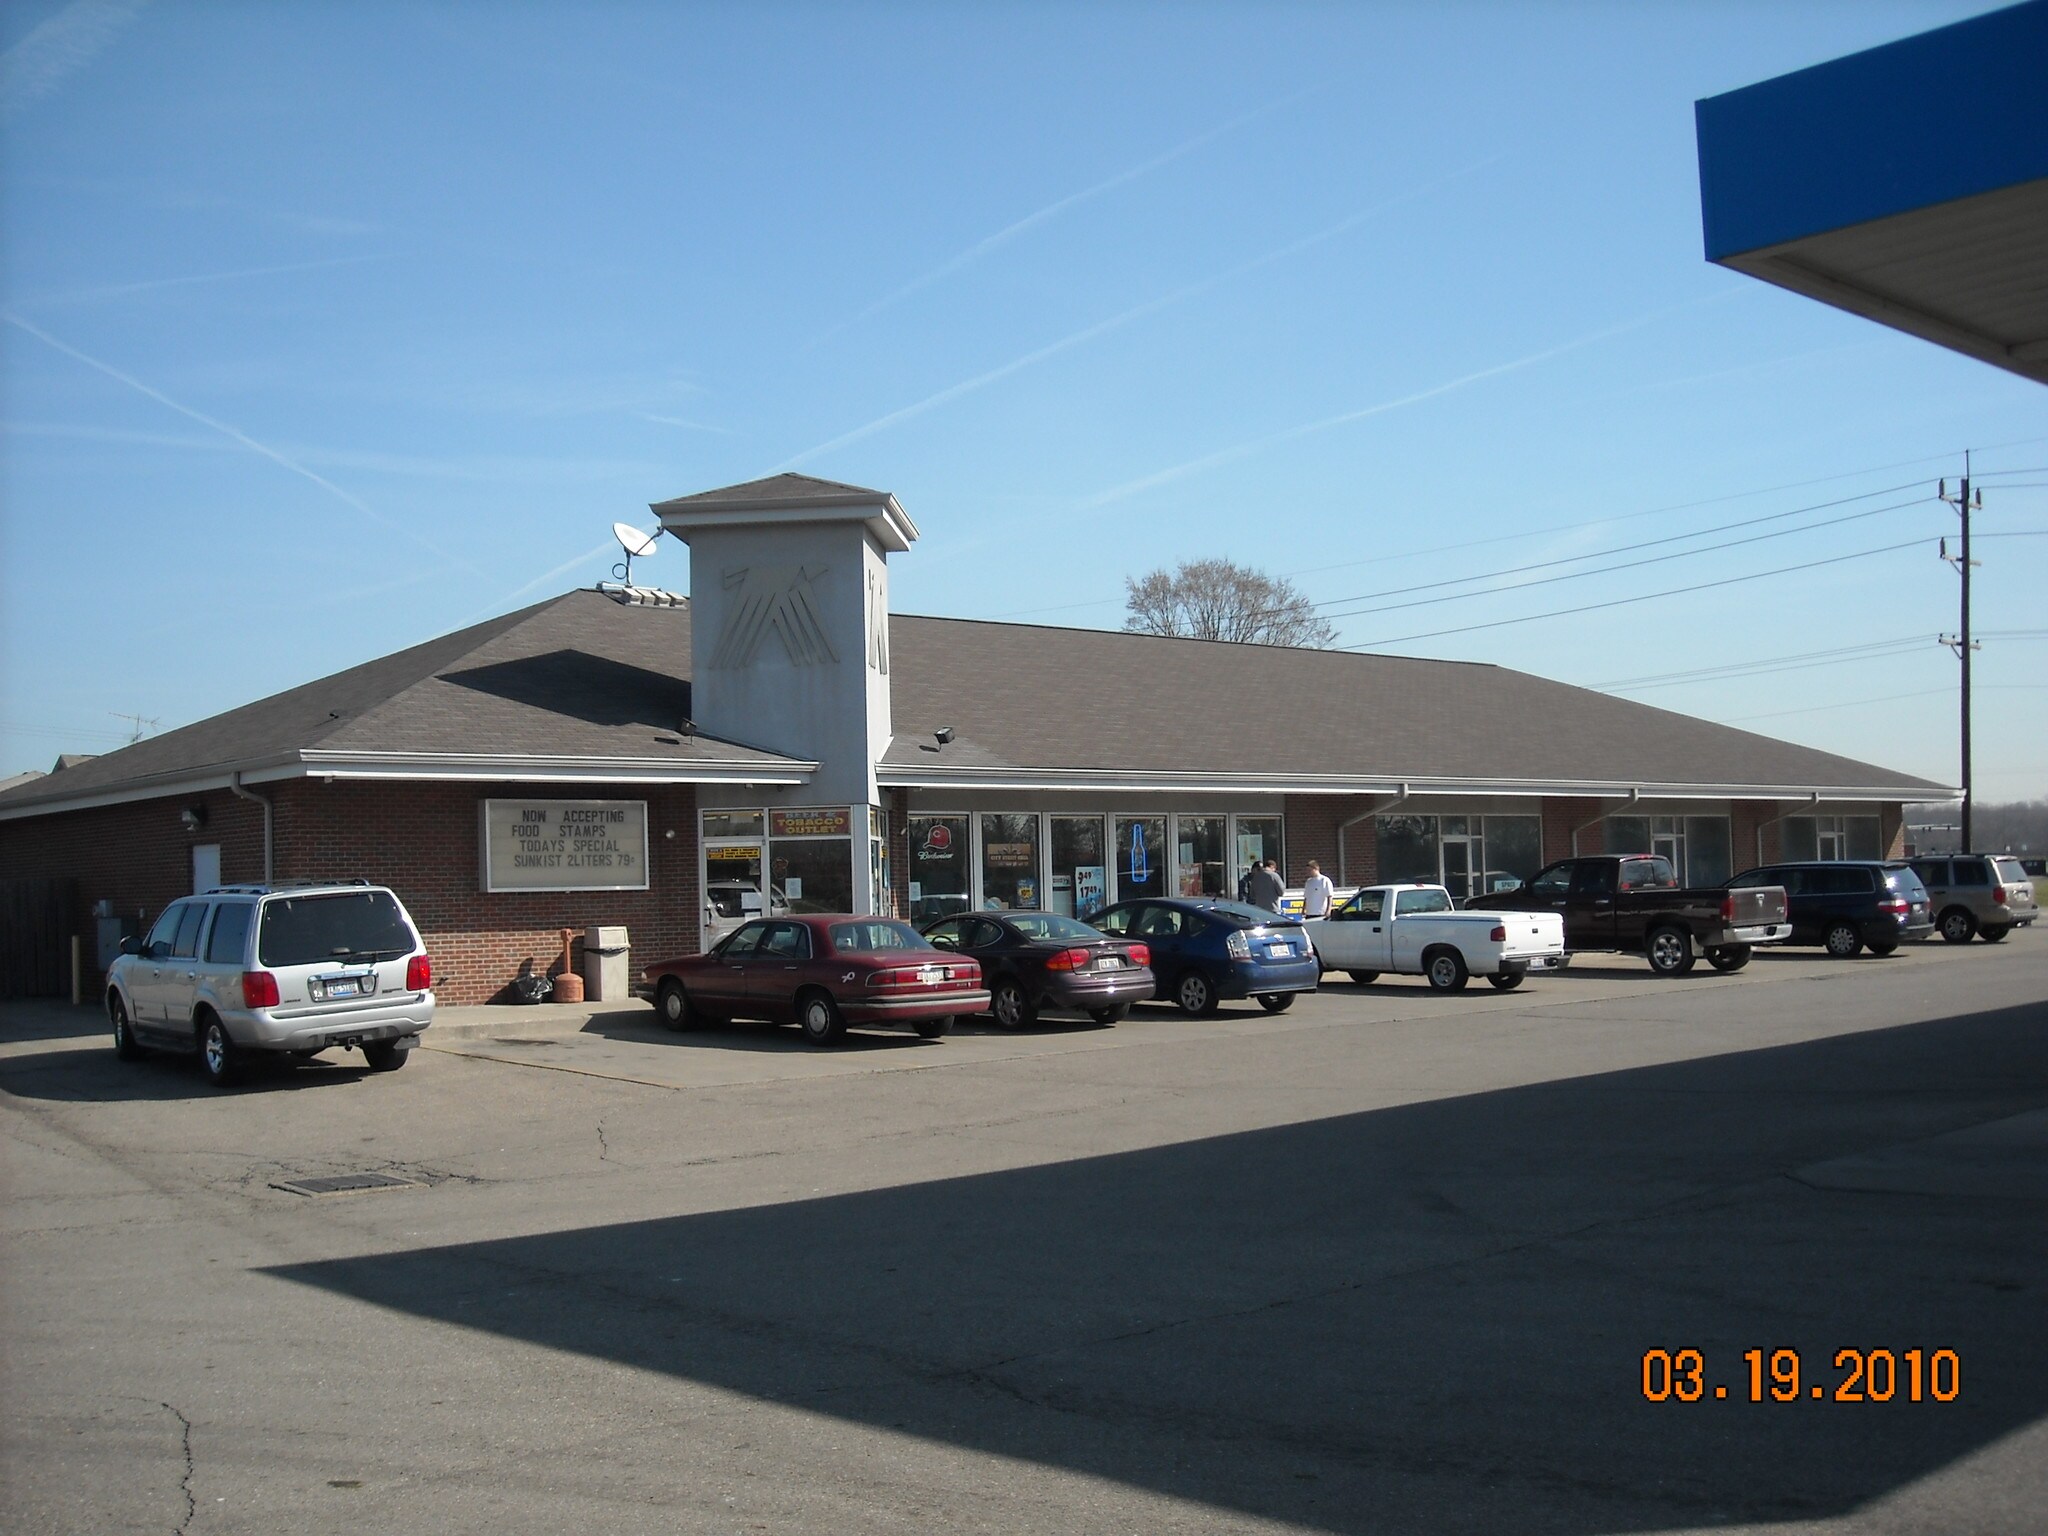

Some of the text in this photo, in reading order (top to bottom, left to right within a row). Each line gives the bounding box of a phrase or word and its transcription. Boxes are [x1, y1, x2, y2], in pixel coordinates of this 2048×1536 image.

[522, 810, 625, 823] NOW ACCEPTING
[784, 811, 819, 819] BEER
[776, 817, 845, 826] TOBACCO
[511, 825, 606, 837] FOOD STAMPS
[784, 825, 838, 835] OUTLET
[519, 839, 620, 852] TODAYS SPECIAL
[514, 854, 562, 867] SUNKIST
[567, 854, 613, 867] 2LITERS
